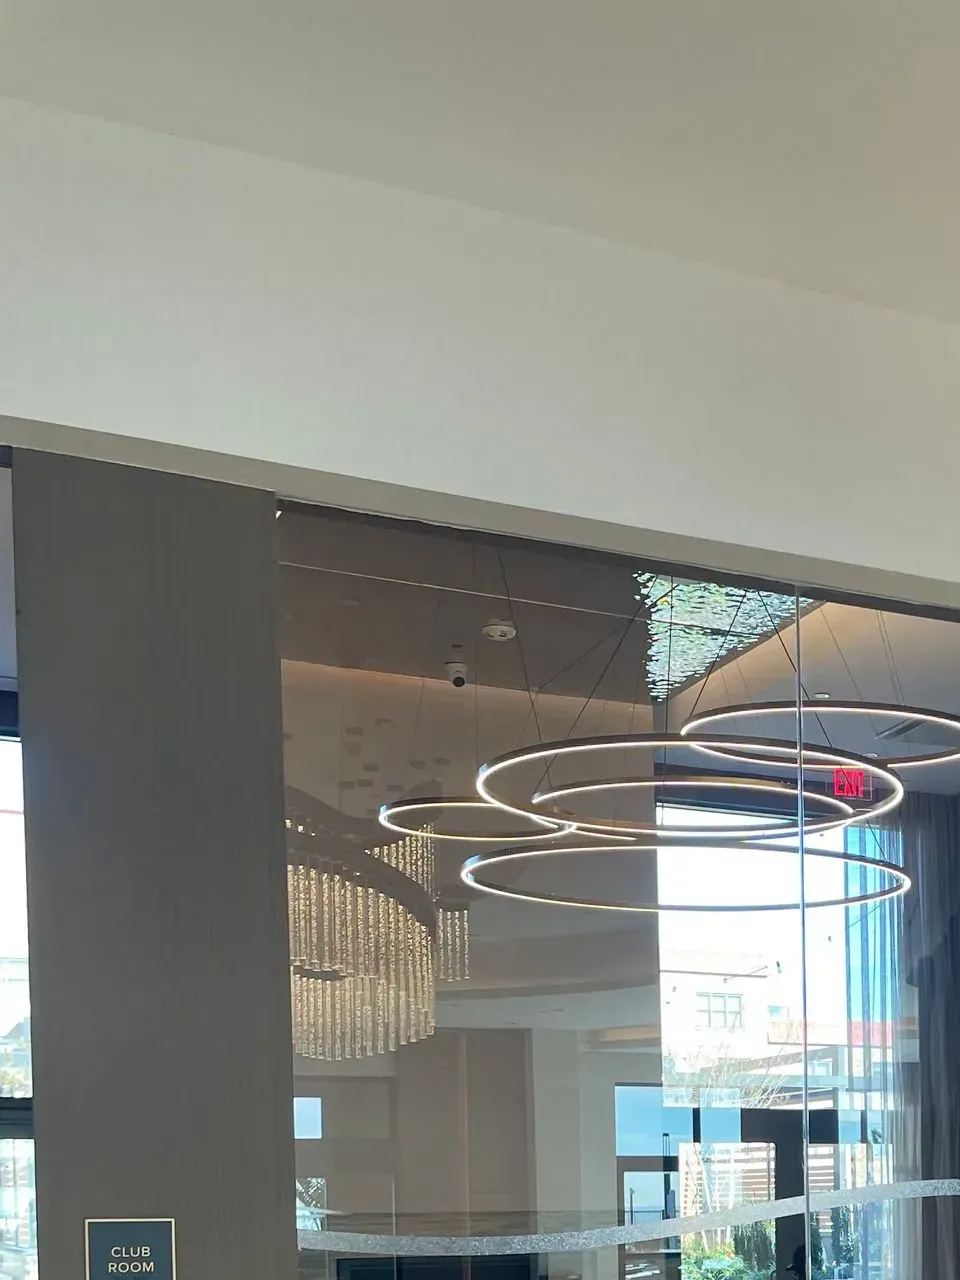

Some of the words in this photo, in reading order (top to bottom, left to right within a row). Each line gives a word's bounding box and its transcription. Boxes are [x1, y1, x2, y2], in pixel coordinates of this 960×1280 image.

[833, 769, 864, 797] EXIT
[111, 1246, 151, 1257] CLUB
[108, 1261, 154, 1273] ROOM
